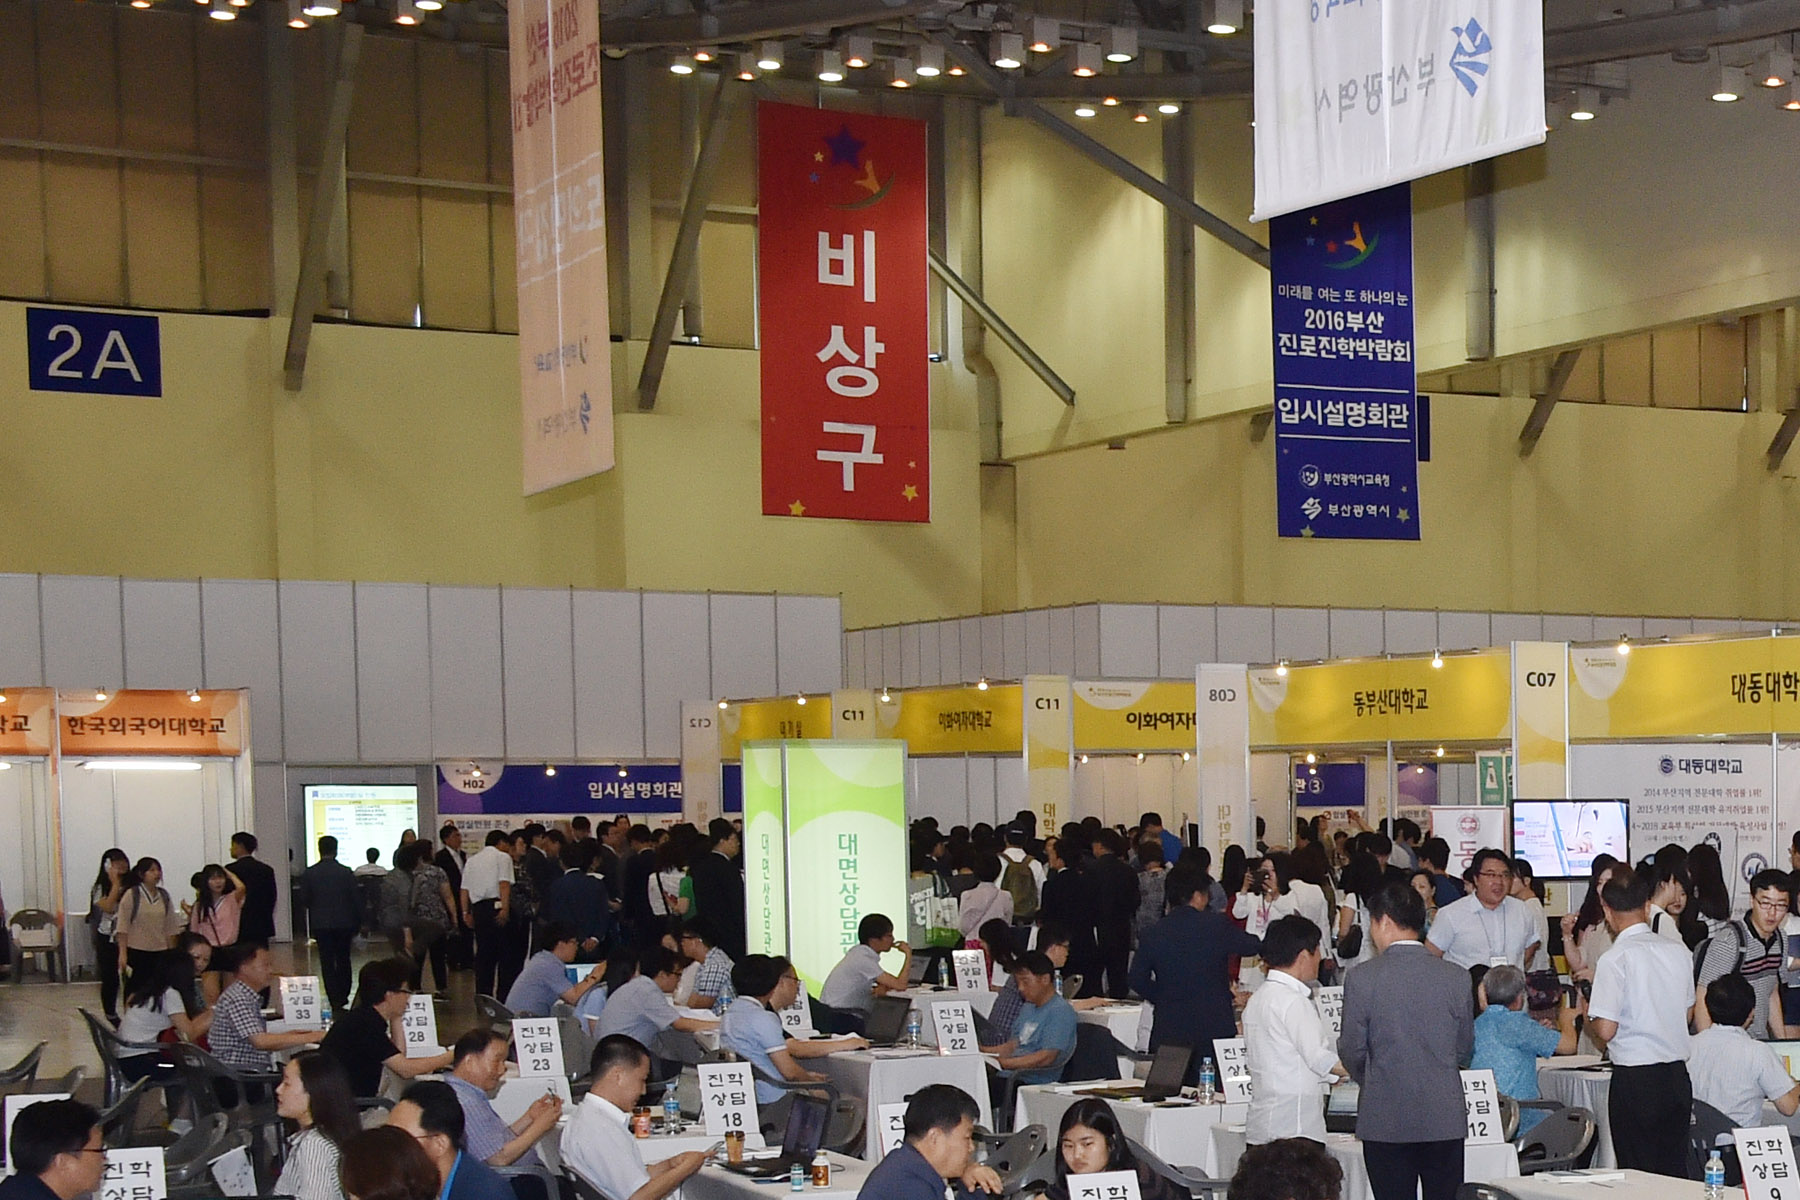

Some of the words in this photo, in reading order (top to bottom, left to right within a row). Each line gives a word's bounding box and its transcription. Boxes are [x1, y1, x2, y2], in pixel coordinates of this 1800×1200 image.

[1278, 284, 1313, 302] 미래를
[1317, 286, 1341, 302] 여는
[1344, 289, 1357, 303] 또
[1359, 289, 1395, 306] 하나의
[47, 323, 144, 384] 2A
[1278, 332, 1412, 363] 진로진학박람회
[816, 230, 886, 492] 비상구
[1278, 398, 1410, 429] 입시설명회관
[1323, 473, 1391, 488] 부산광역시교육청
[1328, 504, 1391, 519] 부산광역시
[1526, 671, 1557, 688] C07
[1035, 697, 1060, 710] C11
[1353, 688, 1429, 718] 동부산대학교
[842, 709, 865, 721] C11
[938, 709, 993, 733] 이화여자대학교
[67, 716, 227, 736] 한국외국어대학교
[1678, 759, 1744, 775] 대동대학교
[463, 779, 486, 790] H02
[587, 781, 683, 800] 입시설명회관
[837, 833, 861, 956] 대면상담관
[966, 980, 979, 989] 31
[295, 1009, 311, 1020] 33
[786, 1014, 801, 1026] 29
[939, 1008, 966, 1020] 진학
[520, 1026, 553, 1039] 진학
[942, 1022, 969, 1034] 상담
[408, 1031, 425, 1042] 28
[950, 1038, 967, 1050] 22
[523, 1041, 554, 1054] 상담
[532, 1058, 551, 1071] 23
[707, 1072, 745, 1089] 진학
[711, 1091, 747, 1108] 상담
[722, 1112, 743, 1128] 18
[1468, 1121, 1489, 1137] 12
[1746, 1136, 1785, 1156] 진학
[103, 1160, 153, 1181] 진학
[1751, 1161, 1790, 1181] 상담
